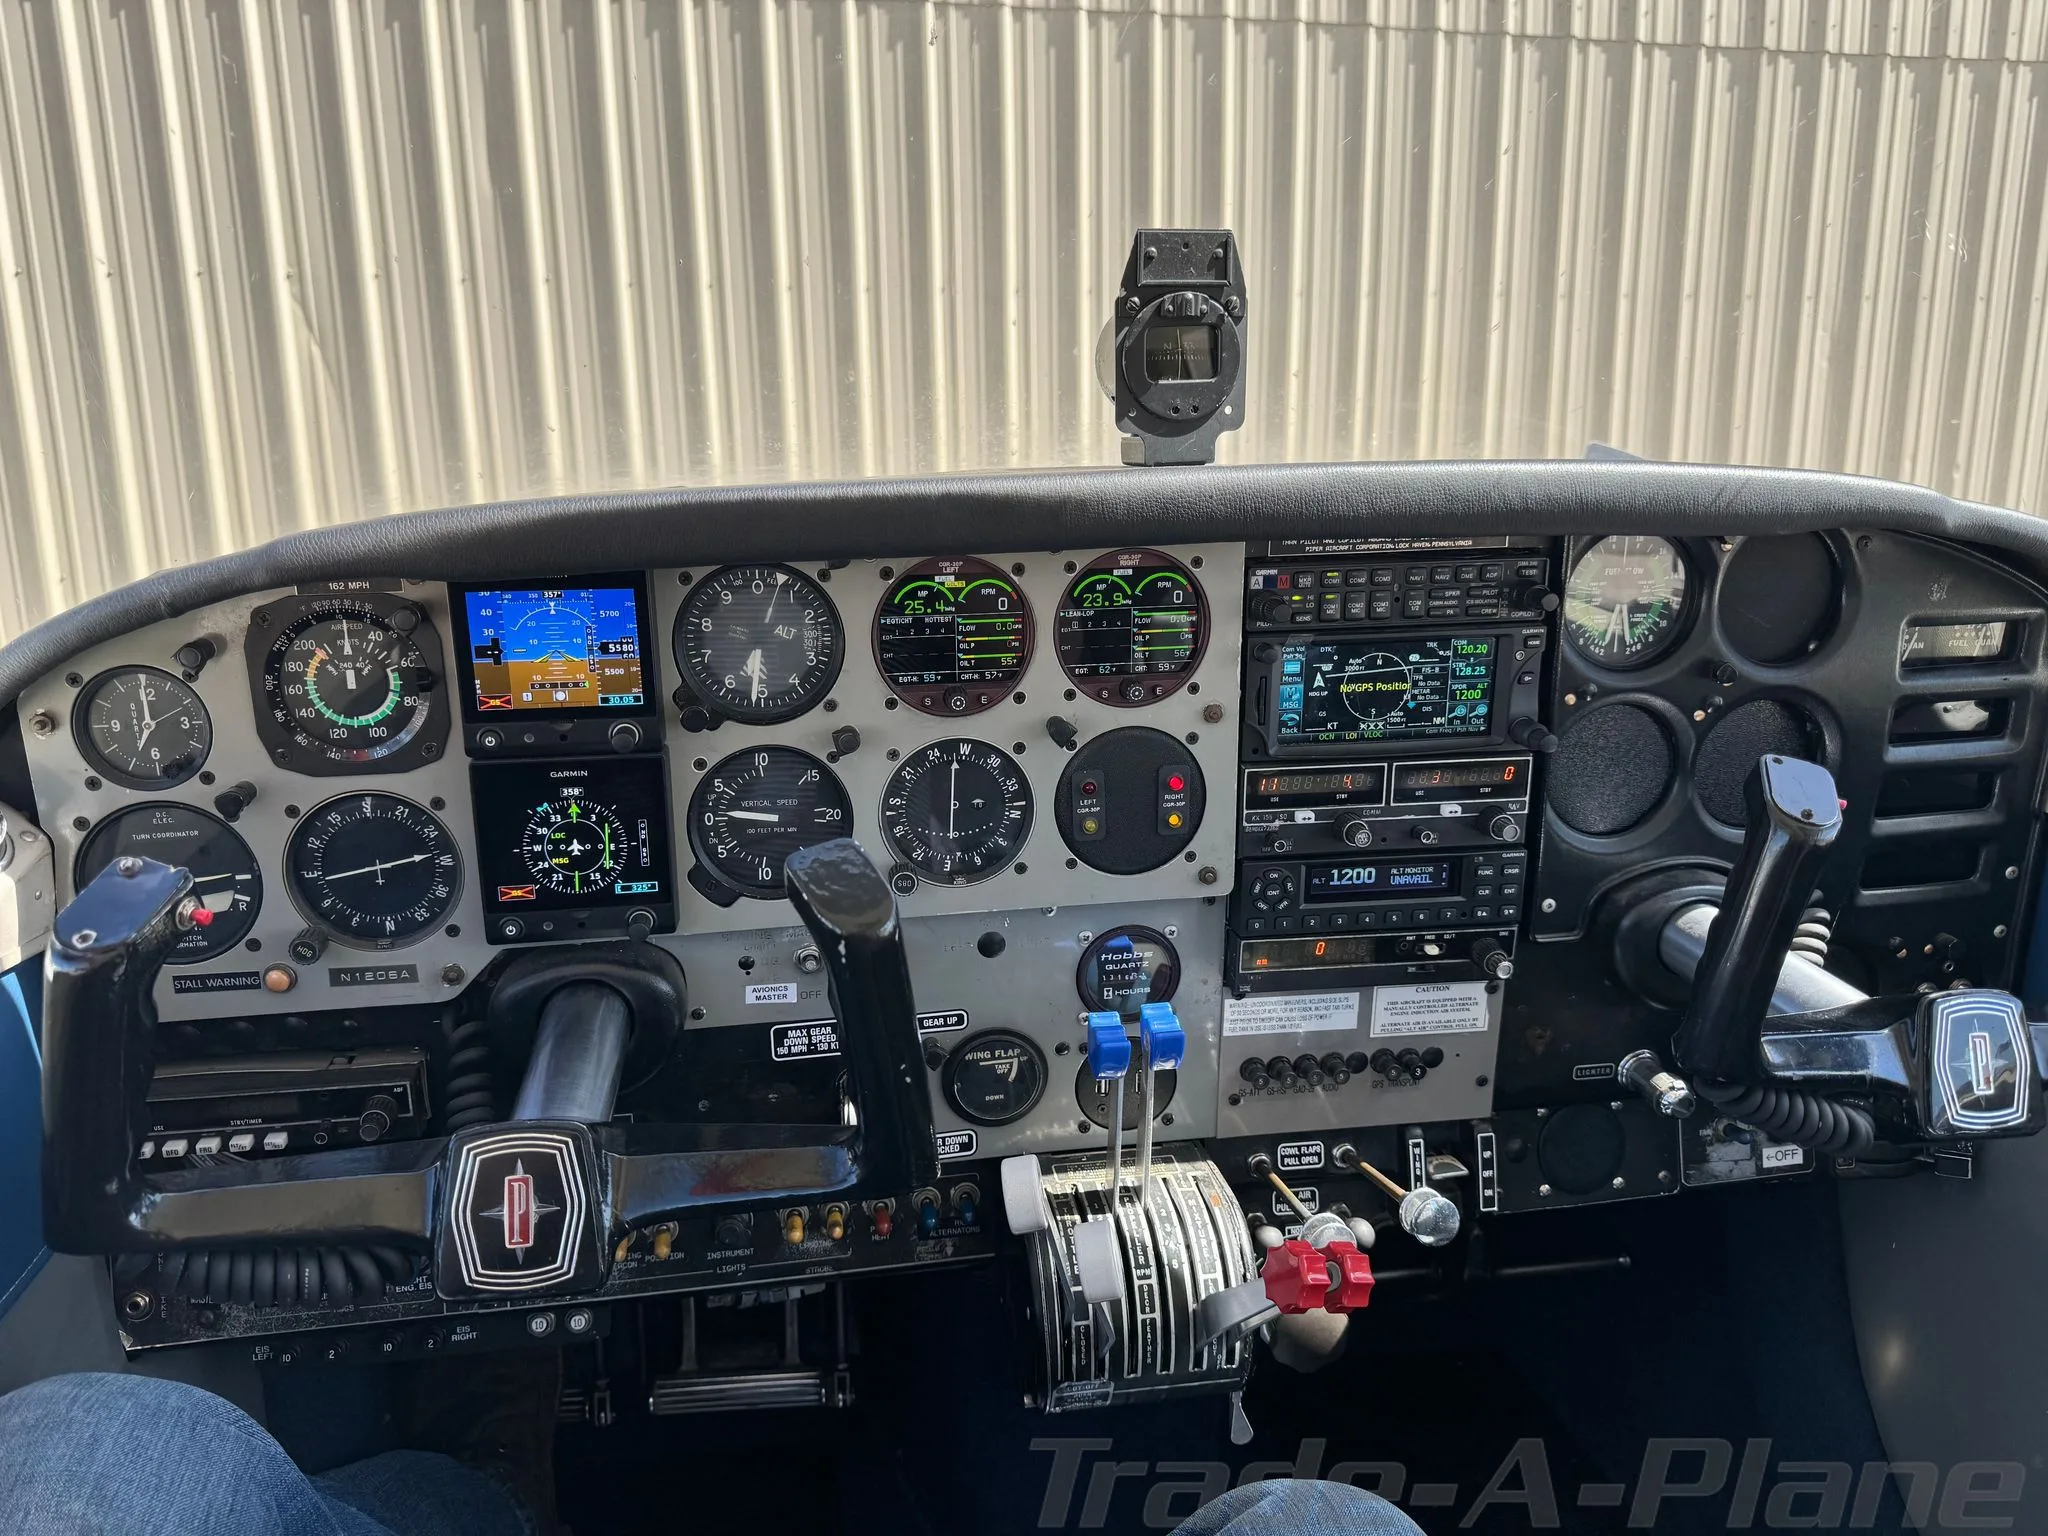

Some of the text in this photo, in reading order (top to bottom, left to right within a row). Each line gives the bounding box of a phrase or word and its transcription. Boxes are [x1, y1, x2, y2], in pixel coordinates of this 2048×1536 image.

[752, 580, 763, 594] 0
[721, 591, 732, 604] 9
[805, 610, 815, 623] 2
[701, 618, 712, 631] 8
[368, 631, 383, 641] 40
[774, 625, 797, 639] ALT
[294, 640, 316, 650] 200
[1457, 645, 1487, 653] 120.20
[701, 650, 712, 663] 7
[806, 652, 816, 665] 3
[284, 661, 303, 672] 180
[1456, 667, 1486, 675] 128.25
[725, 675, 735, 688] 6
[789, 673, 799, 686] 4
[284, 686, 302, 695] 160
[1355, 683, 1373, 691] GPS
[1456, 690, 1481, 699] 1200
[403, 696, 419, 706] 80
[295, 709, 315, 718] 140
[111, 720, 120, 732] 9
[180, 717, 189, 729] 3
[330, 728, 347, 738] 120
[369, 727, 387, 737] 100
[151, 748, 160, 759] 6
[928, 748, 940, 760] 24
[960, 743, 971, 754] W
[755, 753, 768, 766] 10
[987, 754, 1000, 767] 30
[808, 770, 820, 781] 15
[902, 767, 914, 779] 21
[1006, 778, 1018, 791] 33
[395, 806, 409, 817] 21
[825, 809, 841, 820] 20
[327, 812, 341, 825] 15
[152, 830, 199, 839] COORDINATOR
[423, 825, 438, 838] 24
[1330, 868, 1375, 885] 1200
[1391, 874, 1432, 884] UNAVAIL
[297, 945, 313, 957] HDG
[1101, 951, 1153, 960] Hobbs
[1106, 962, 1149, 970] QUARTZ
[341, 970, 410, 981] N1206A
[175, 977, 259, 989] STALL WARNING
[800, 991, 821, 999] OFF
[1115, 987, 1150, 995] HOURS
[788, 1027, 832, 1037] MAX GEAR
[784, 1035, 836, 1046] DOWN SPEED
[777, 1043, 828, 1055] 150 MPH 130
[965, 1049, 1021, 1060] WING FLAP
[1577, 1067, 1611, 1077] LIGHTER
[945, 1136, 968, 1144] DOWN
[1281, 1145, 1321, 1156] COWL FLAPS
[1284, 1156, 1318, 1166] PULL OPEN
[930, 1226, 980, 1237] ALTERNATORS
[707, 1248, 754, 1260] INSTRUMENT
[717, 1264, 746, 1273] LIGHTS
[535, 1321, 543, 1330] 10
[574, 1318, 582, 1327] 10
[452, 1332, 477, 1341] RIGHT
